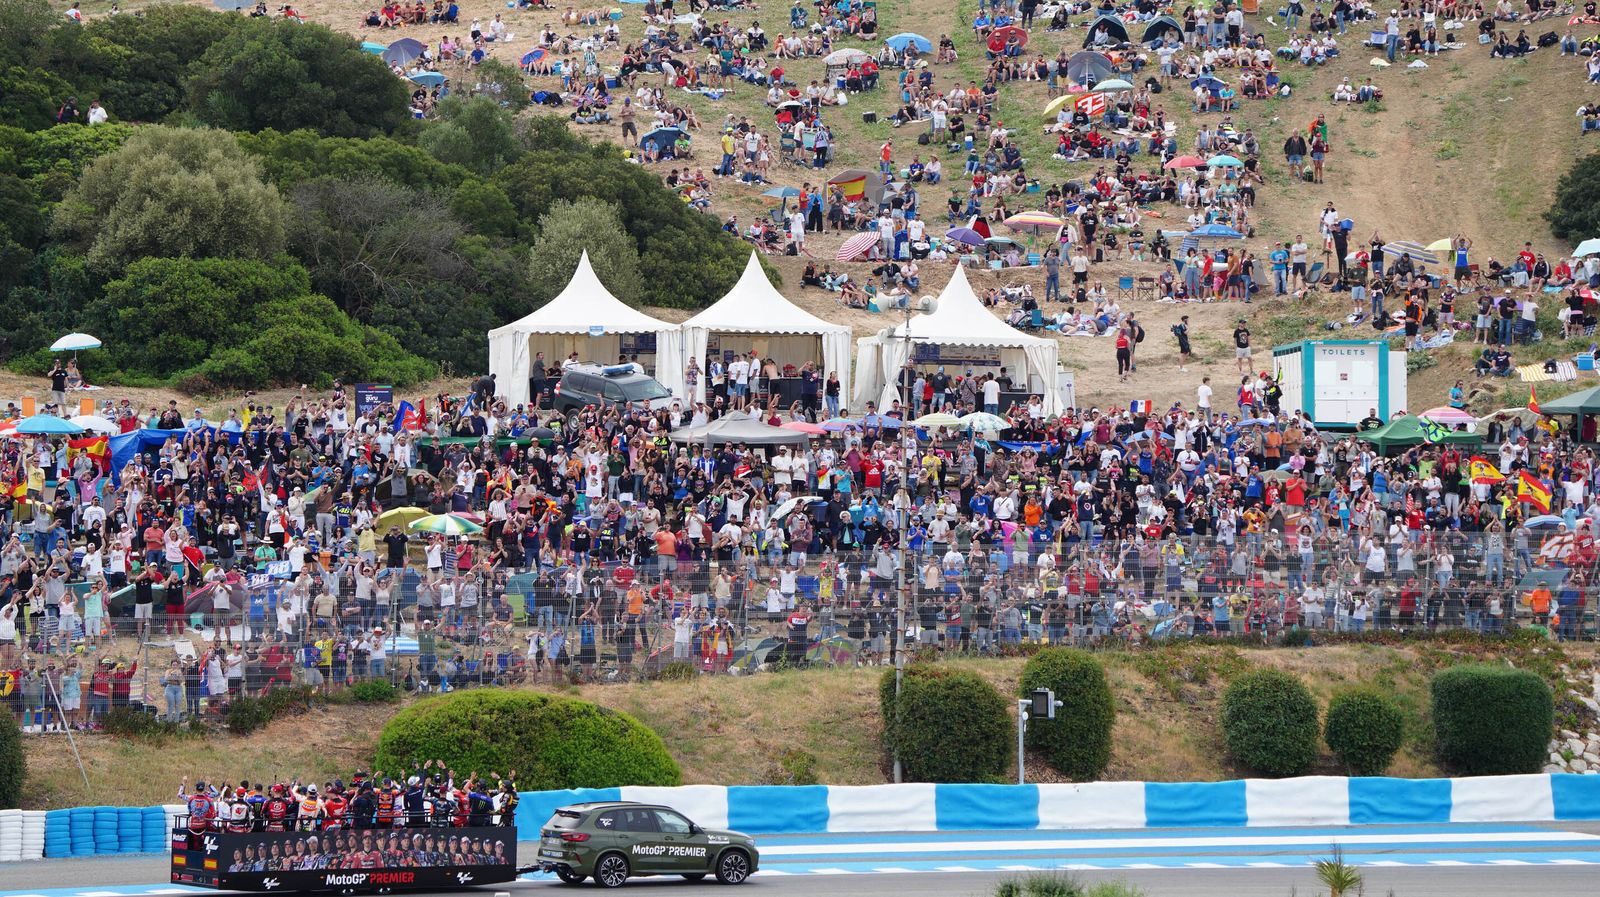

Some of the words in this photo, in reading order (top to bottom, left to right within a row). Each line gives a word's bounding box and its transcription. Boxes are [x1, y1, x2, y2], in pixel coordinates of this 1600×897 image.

[632, 844, 666, 855] MotoGP
[668, 846, 707, 857] PREMIER
[326, 873, 366, 885] MotoGP
[369, 872, 415, 884] PREMIER
